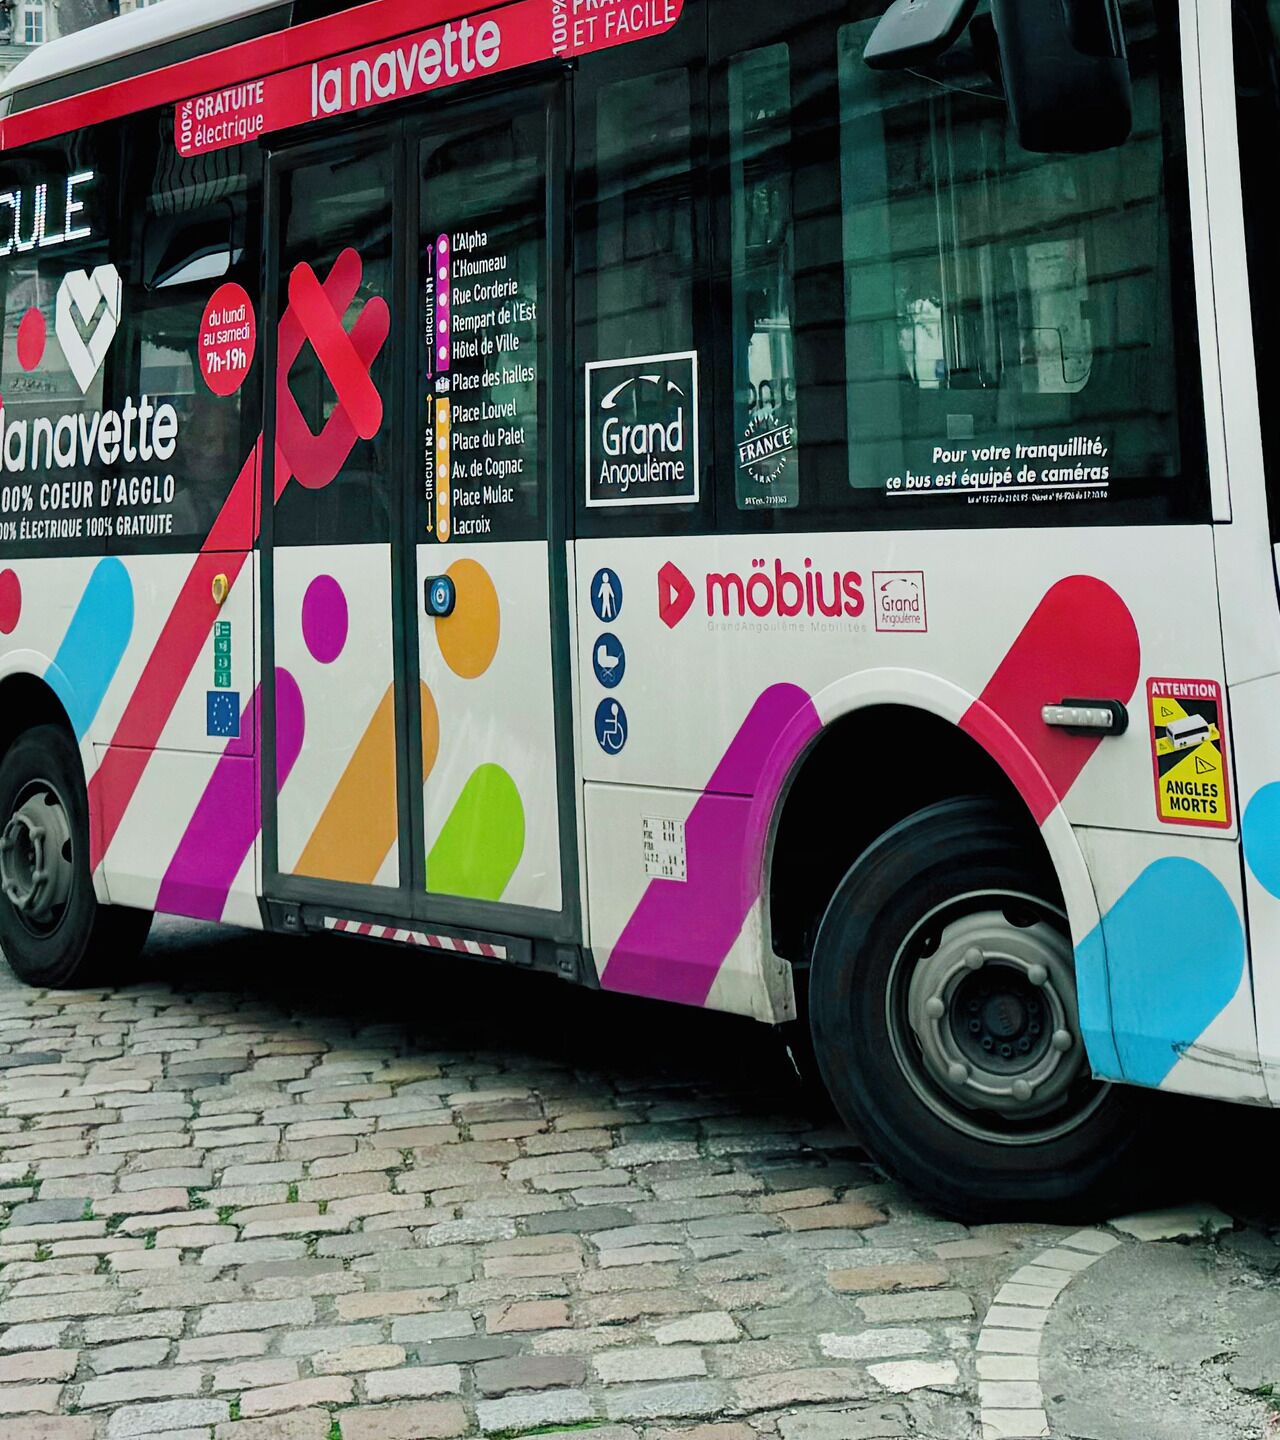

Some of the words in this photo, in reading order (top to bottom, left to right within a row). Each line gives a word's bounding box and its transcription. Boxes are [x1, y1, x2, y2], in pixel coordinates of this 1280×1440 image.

[573, 15, 599, 47] ET
[311, 62, 342, 118] la
[349, 17, 502, 106] navette
[195, 80, 264, 121] GRATUITE
[181, 101, 193, 152] 100%
[195, 113, 264, 148] électrique
[452, 230, 487, 252] L'Alpha
[452, 255, 507, 278] L'Houmeau
[452, 287, 471, 305] Rue
[474, 278, 518, 301] Corderie
[209, 310, 221, 327] du
[222, 304, 246, 324] lundi
[452, 311, 496, 334] Rempart
[498, 307, 511, 325] de
[513, 302, 536, 322] l'Est
[203, 333, 215, 346] au
[217, 322, 250, 344] samedi
[452, 339, 478, 360] Hôtel
[481, 338, 493, 356] de
[496, 332, 519, 353] Ville
[206, 348, 247, 374] 7h-19h
[452, 370, 480, 392] Place
[482, 368, 500, 386] des
[503, 364, 534, 385] halles
[452, 405, 480, 424] Place
[482, 398, 517, 420] Louvel
[31, 394, 178, 471] navette
[426, 428, 433, 447] N2
[452, 432, 480, 451] Place
[482, 429, 495, 448] du
[497, 427, 525, 446] Palet
[602, 406, 683, 456] Grand
[932, 446, 968, 464] Pour
[971, 445, 1012, 462] votre
[1015, 436, 1108, 461] tranquillité,
[452, 461, 468, 479] Av.
[470, 459, 483, 477] de
[485, 457, 523, 479] Cognac
[599, 452, 685, 492] Angoulême
[886, 475, 901, 490] ce
[905, 469, 932, 489] bus
[935, 470, 957, 487] est
[960, 466, 1012, 489] équipé
[1016, 464, 1037, 483] de
[1041, 462, 1109, 482] caméras
[39, 480, 94, 511] COEUR
[100, 474, 175, 507] D'AGGLO
[453, 488, 480, 507] Place
[483, 485, 514, 505] Mulac
[20, 516, 83, 540] ÉLECTRIQUE
[86, 516, 113, 537] 100%
[116, 513, 173, 536] GRATUITE
[453, 514, 491, 535] Lacroix
[706, 557, 865, 618] möbius
[881, 593, 919, 612] Grand
[1151, 682, 1217, 698] ATTENTION
[1166, 780, 1218, 798] ANGLES
[1170, 796, 1217, 814] MORTS
